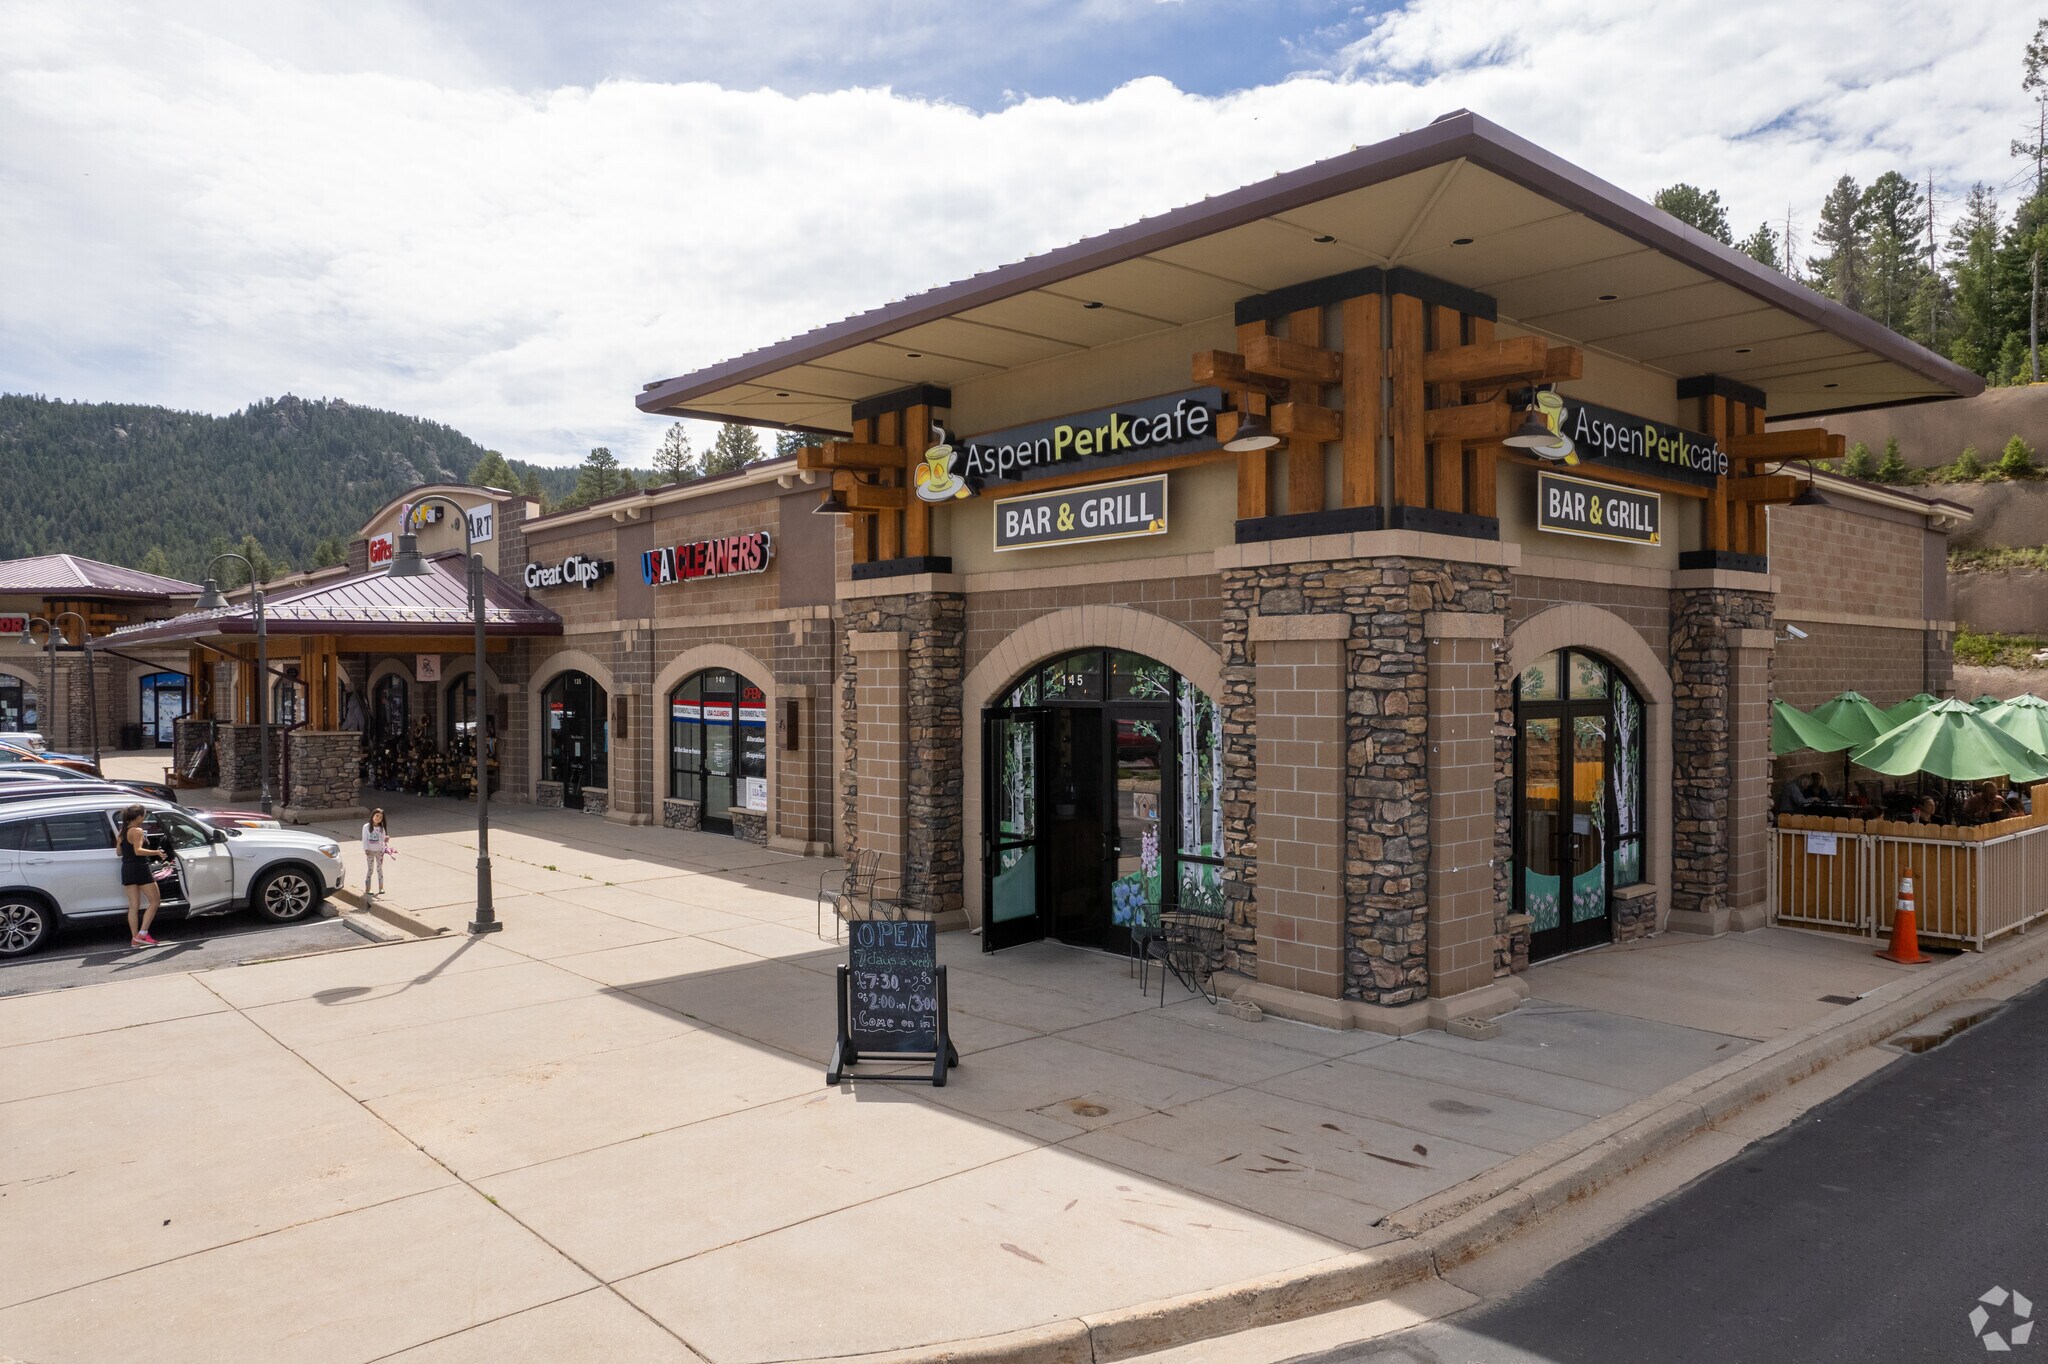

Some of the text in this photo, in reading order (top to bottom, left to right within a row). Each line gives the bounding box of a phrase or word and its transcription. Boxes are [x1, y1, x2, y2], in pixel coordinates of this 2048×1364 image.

[1005, 492, 1154, 538] BAR & GRILL
[1549, 487, 1653, 533] BAR & GRILL
[468, 513, 492, 539] ART
[369, 538, 392, 563] Gifts
[641, 532, 763, 586] USA CLEANERS
[524, 556, 599, 589] Great Clips
[715, 676, 726, 684] 140
[1061, 674, 1084, 687] 145
[744, 687, 762, 700] OPEN
[857, 922, 928, 948] OPEN
[867, 951, 897, 973] days
[859, 1010, 931, 1028] Come on in
